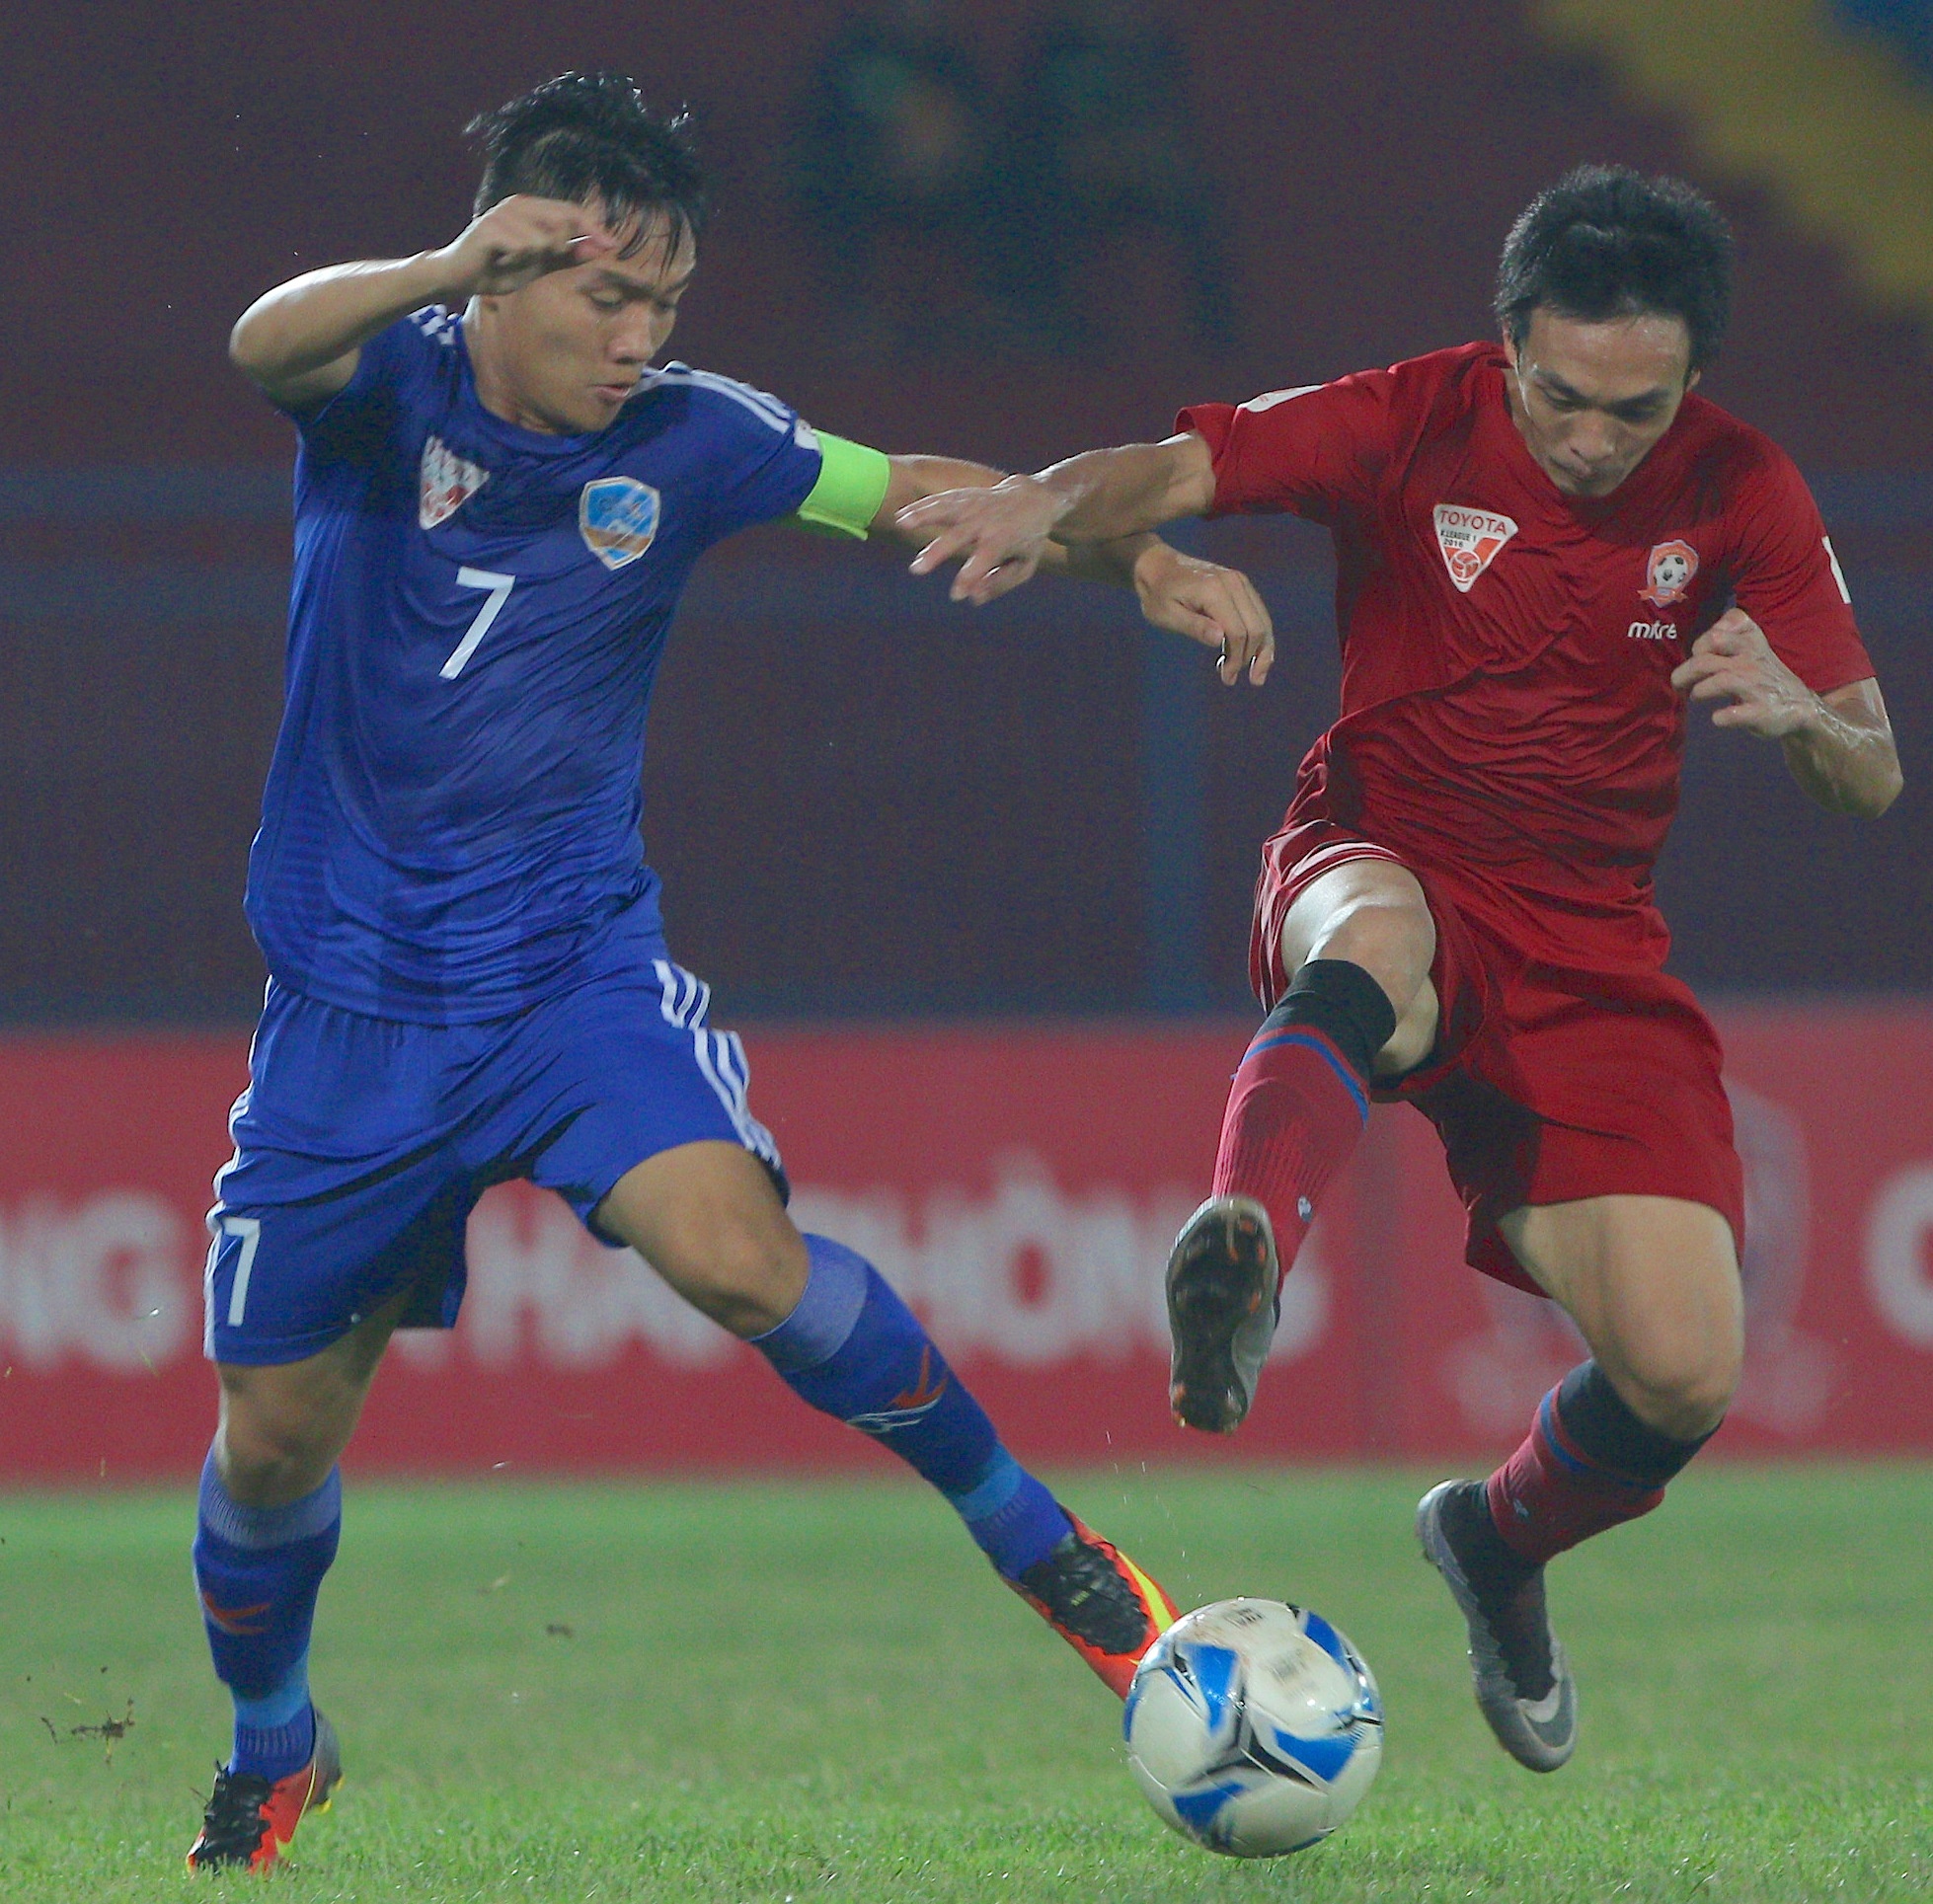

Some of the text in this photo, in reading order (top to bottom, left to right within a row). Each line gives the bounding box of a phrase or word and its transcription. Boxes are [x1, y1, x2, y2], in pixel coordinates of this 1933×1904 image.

[1439, 509, 1507, 535] TOYOTA
[438, 567, 516, 680] 7
[1627, 621, 1678, 640] mitre
[220, 1217, 261, 1327] 7
